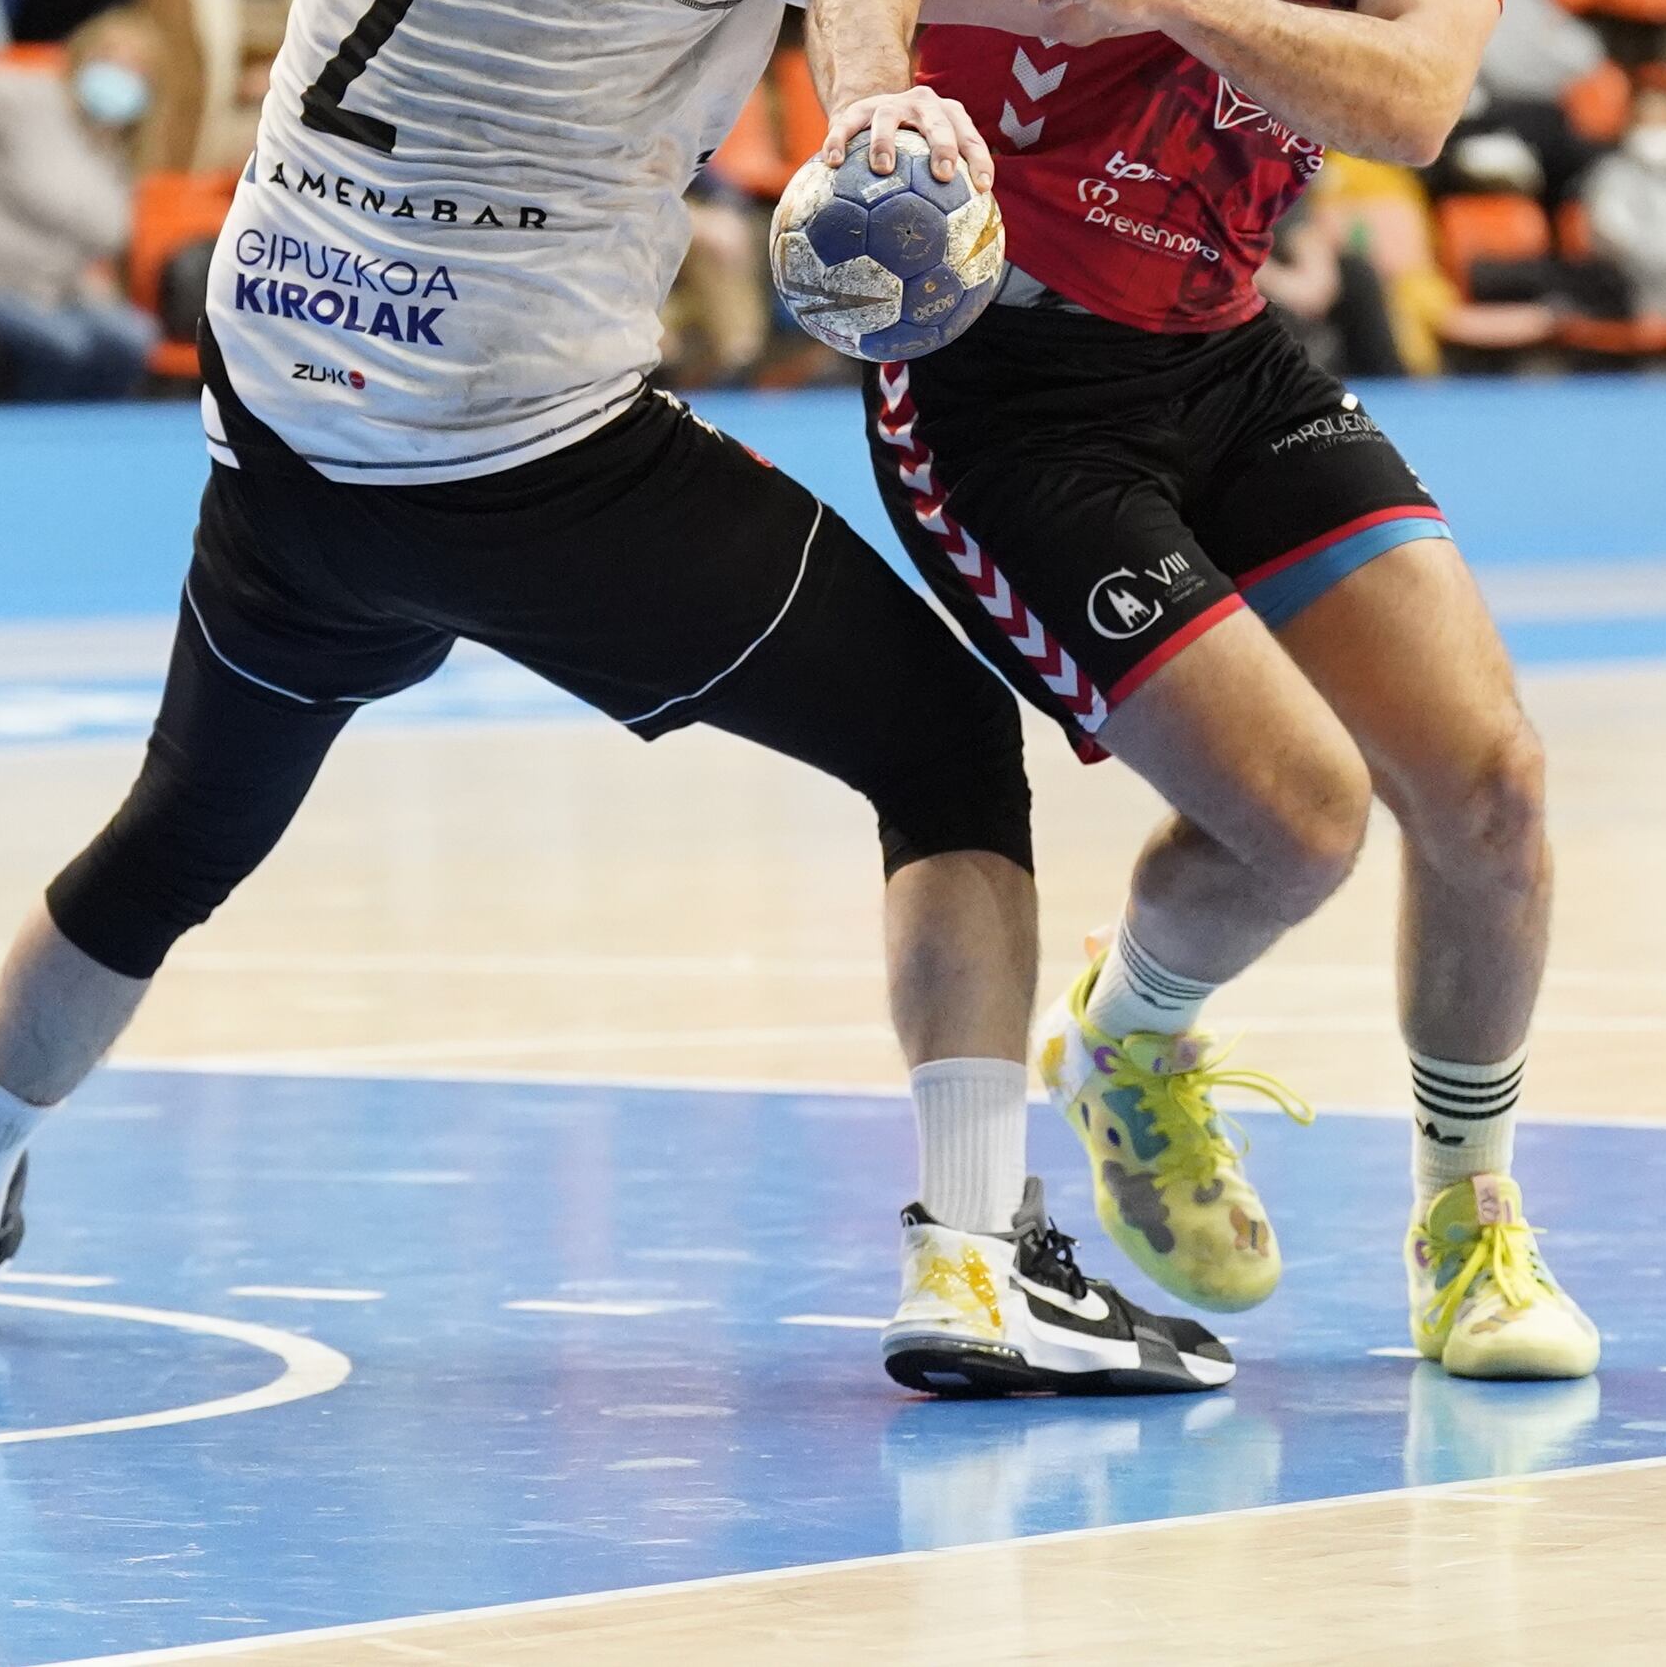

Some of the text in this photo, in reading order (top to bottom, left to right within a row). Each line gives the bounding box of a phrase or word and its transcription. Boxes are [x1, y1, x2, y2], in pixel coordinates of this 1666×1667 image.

[268, 161, 548, 230] AMENABAR
[235, 228, 459, 301] GIPUZKOA
[234, 273, 446, 346] KIROLAK
[1144, 550, 1191, 586] VIII
